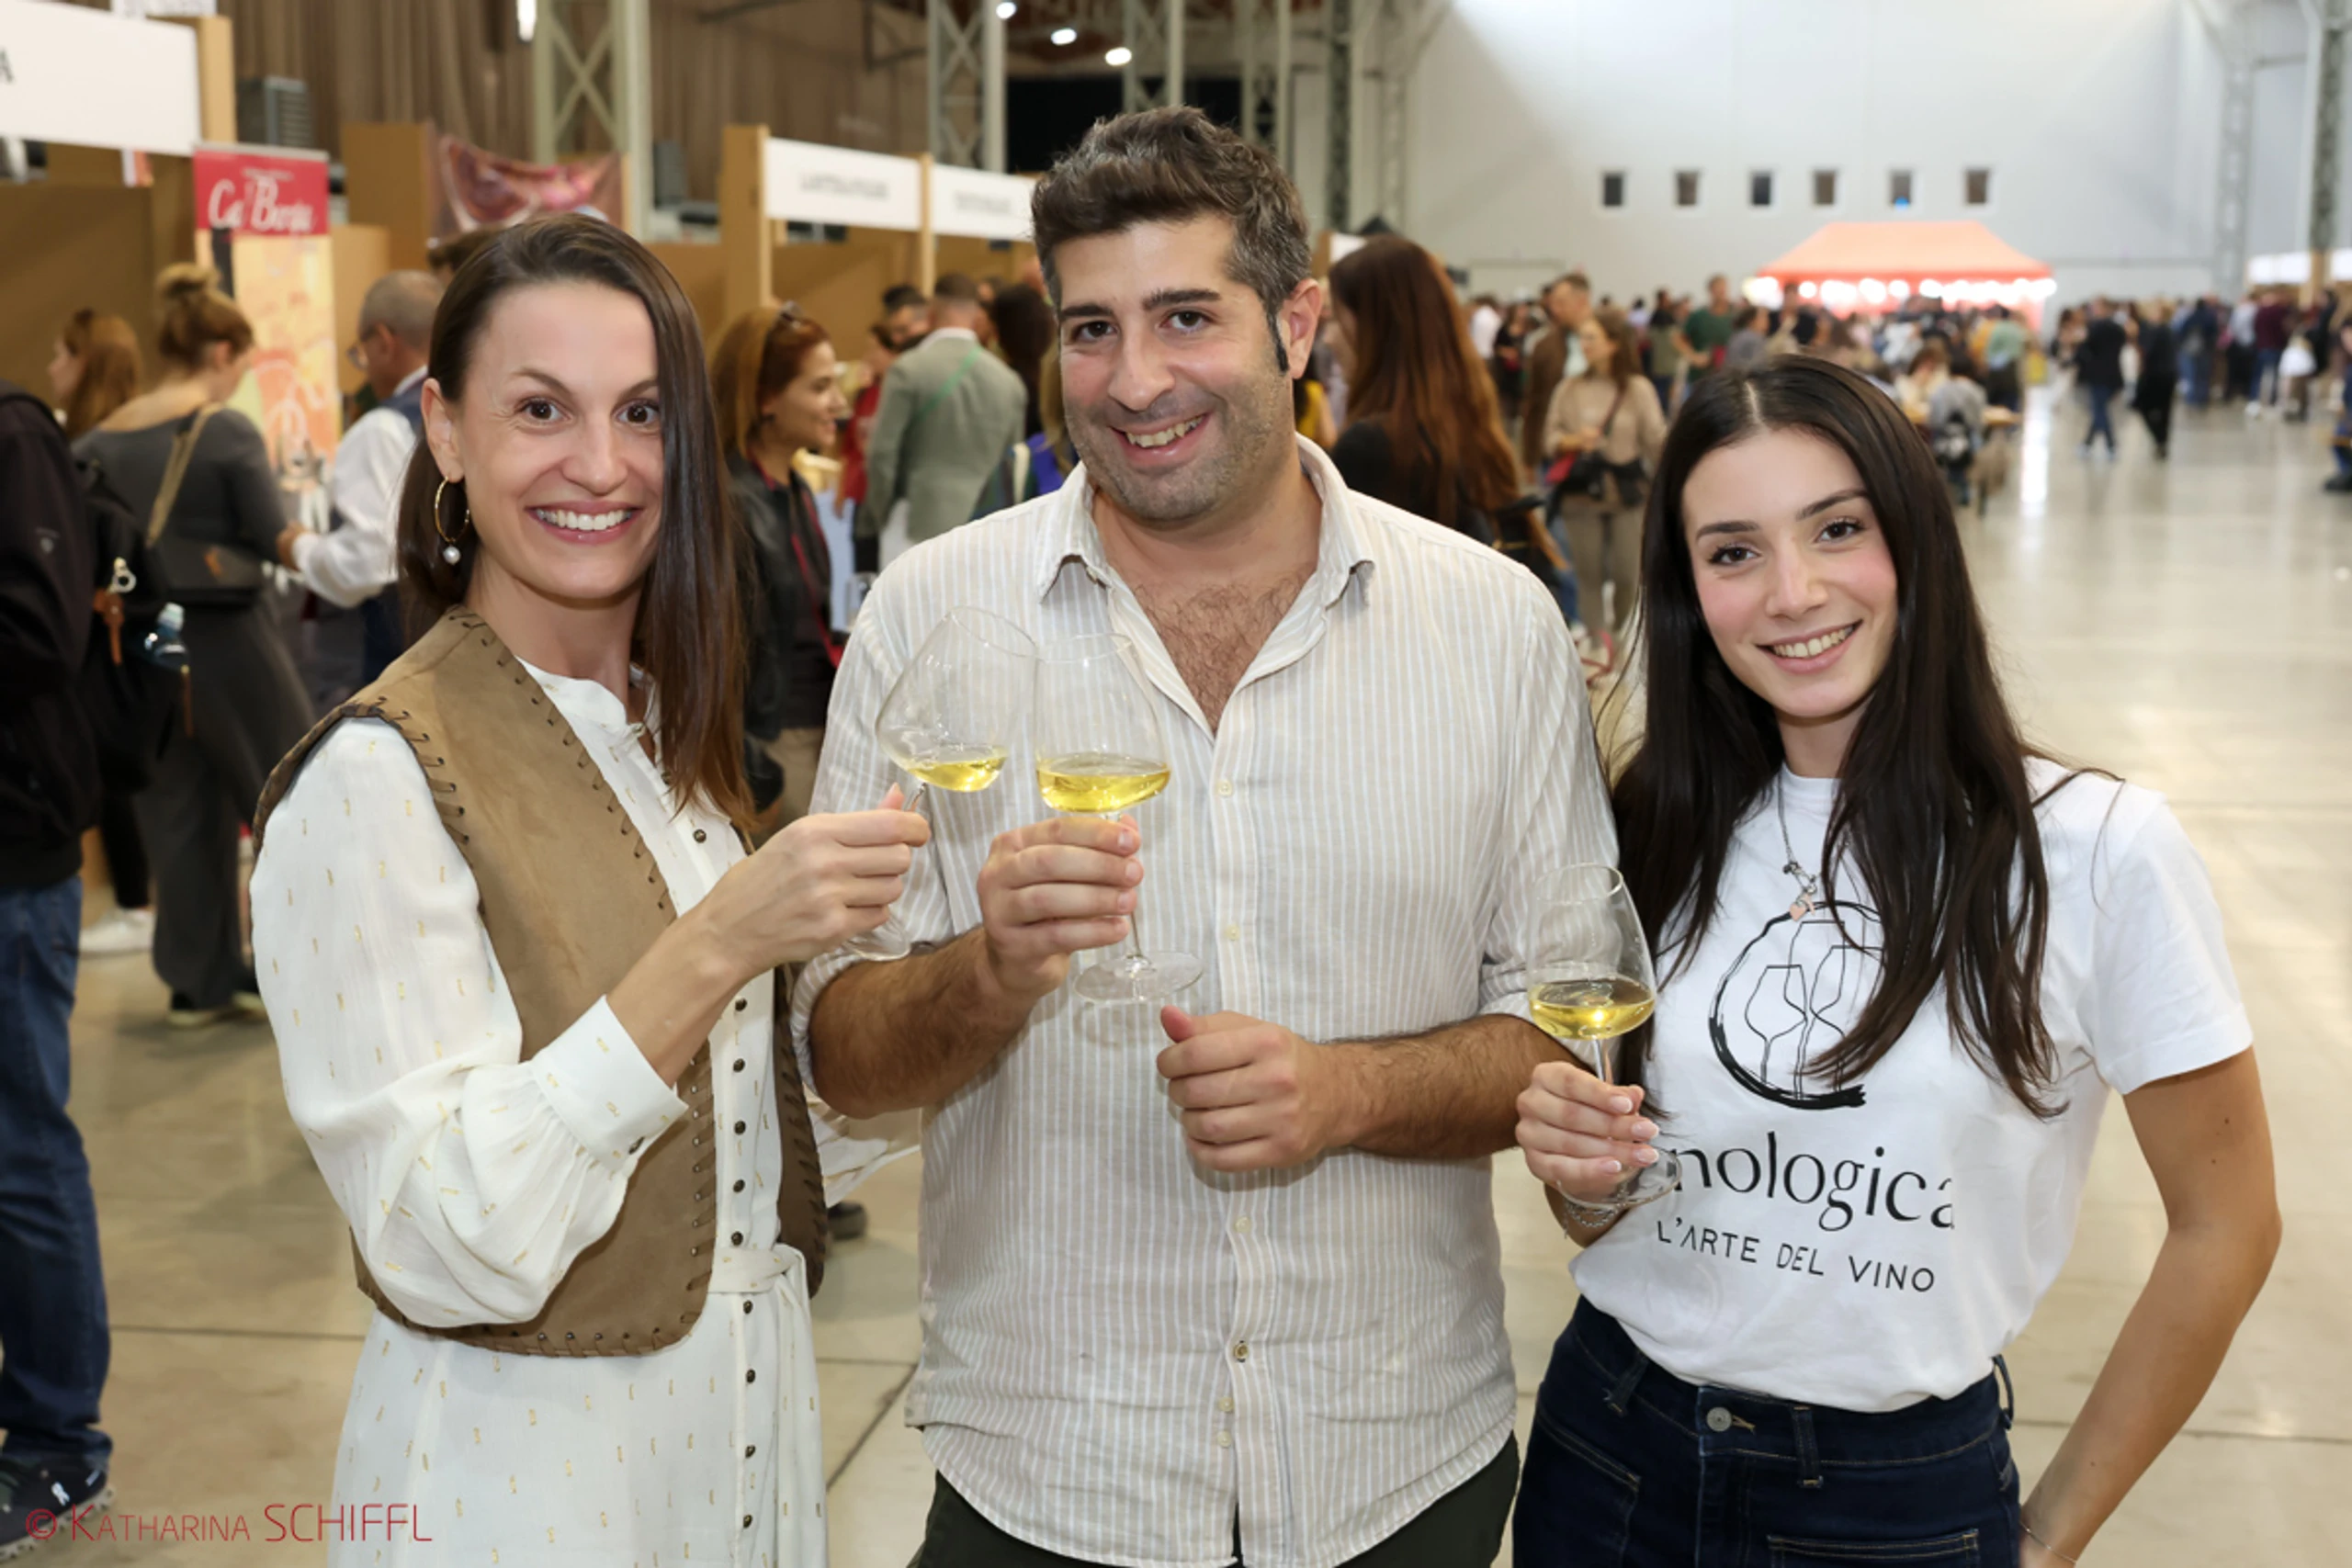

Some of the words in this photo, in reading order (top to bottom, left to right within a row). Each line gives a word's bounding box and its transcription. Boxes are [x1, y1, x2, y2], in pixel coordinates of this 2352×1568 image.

[1668, 1131, 1954, 1232] nologica
[1657, 1216, 1759, 1263] L'ARTE
[1776, 1243, 1824, 1276] DEL
[1849, 1255, 1934, 1292] VINO
